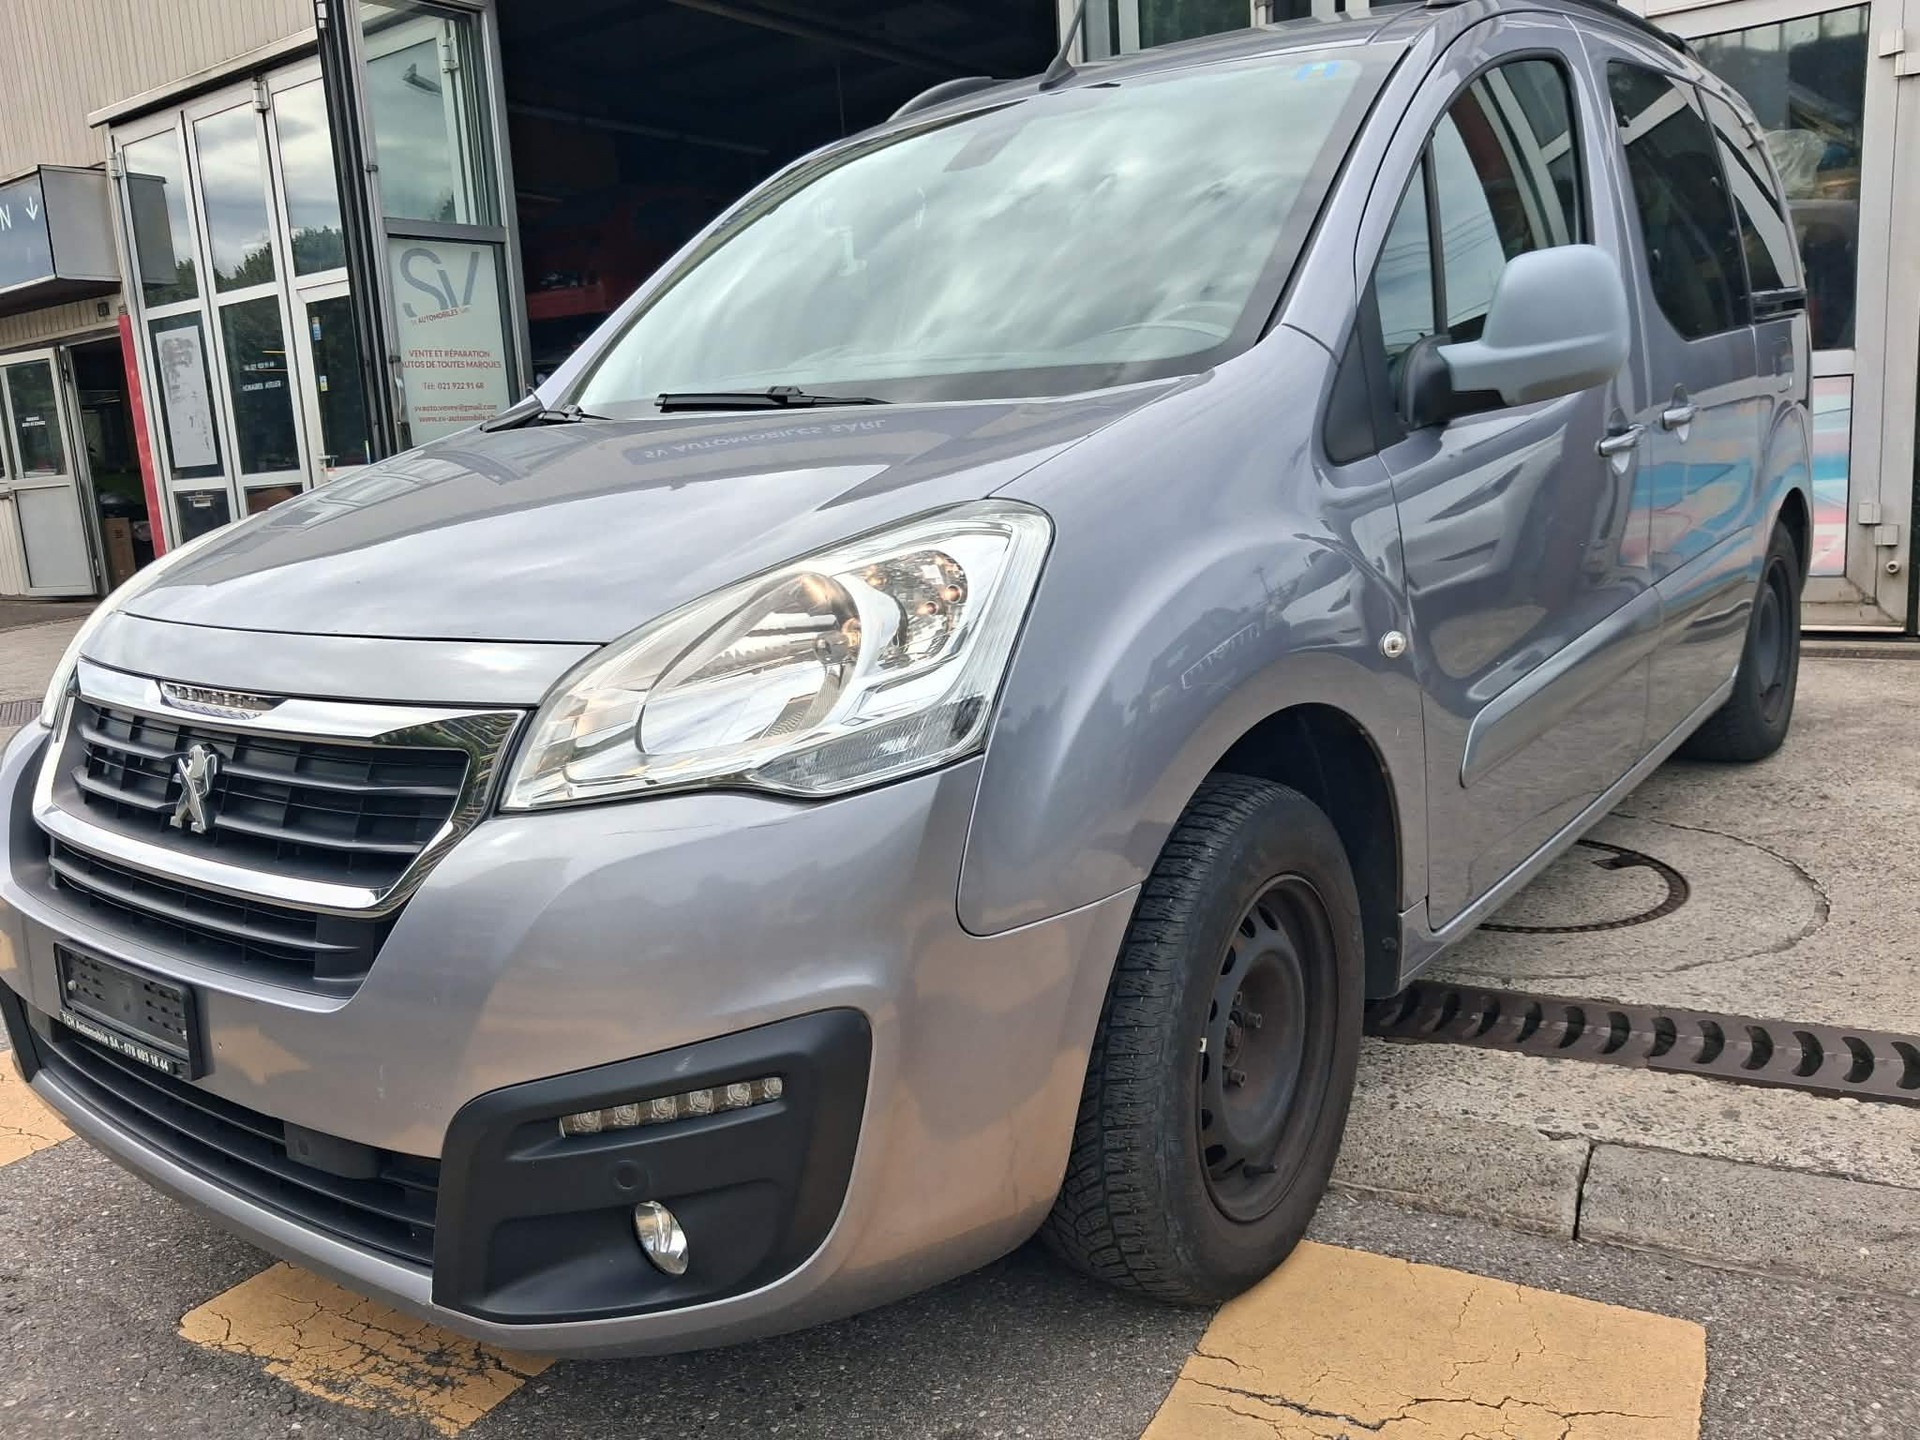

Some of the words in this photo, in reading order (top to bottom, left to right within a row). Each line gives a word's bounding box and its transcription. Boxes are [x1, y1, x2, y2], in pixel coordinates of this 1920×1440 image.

[408, 349, 434, 358] VENTE
[435, 349, 443, 358] ET
[428, 361, 436, 369] DE
[437, 361, 466, 369] TOUTES
[466, 361, 502, 370] MARQUES
